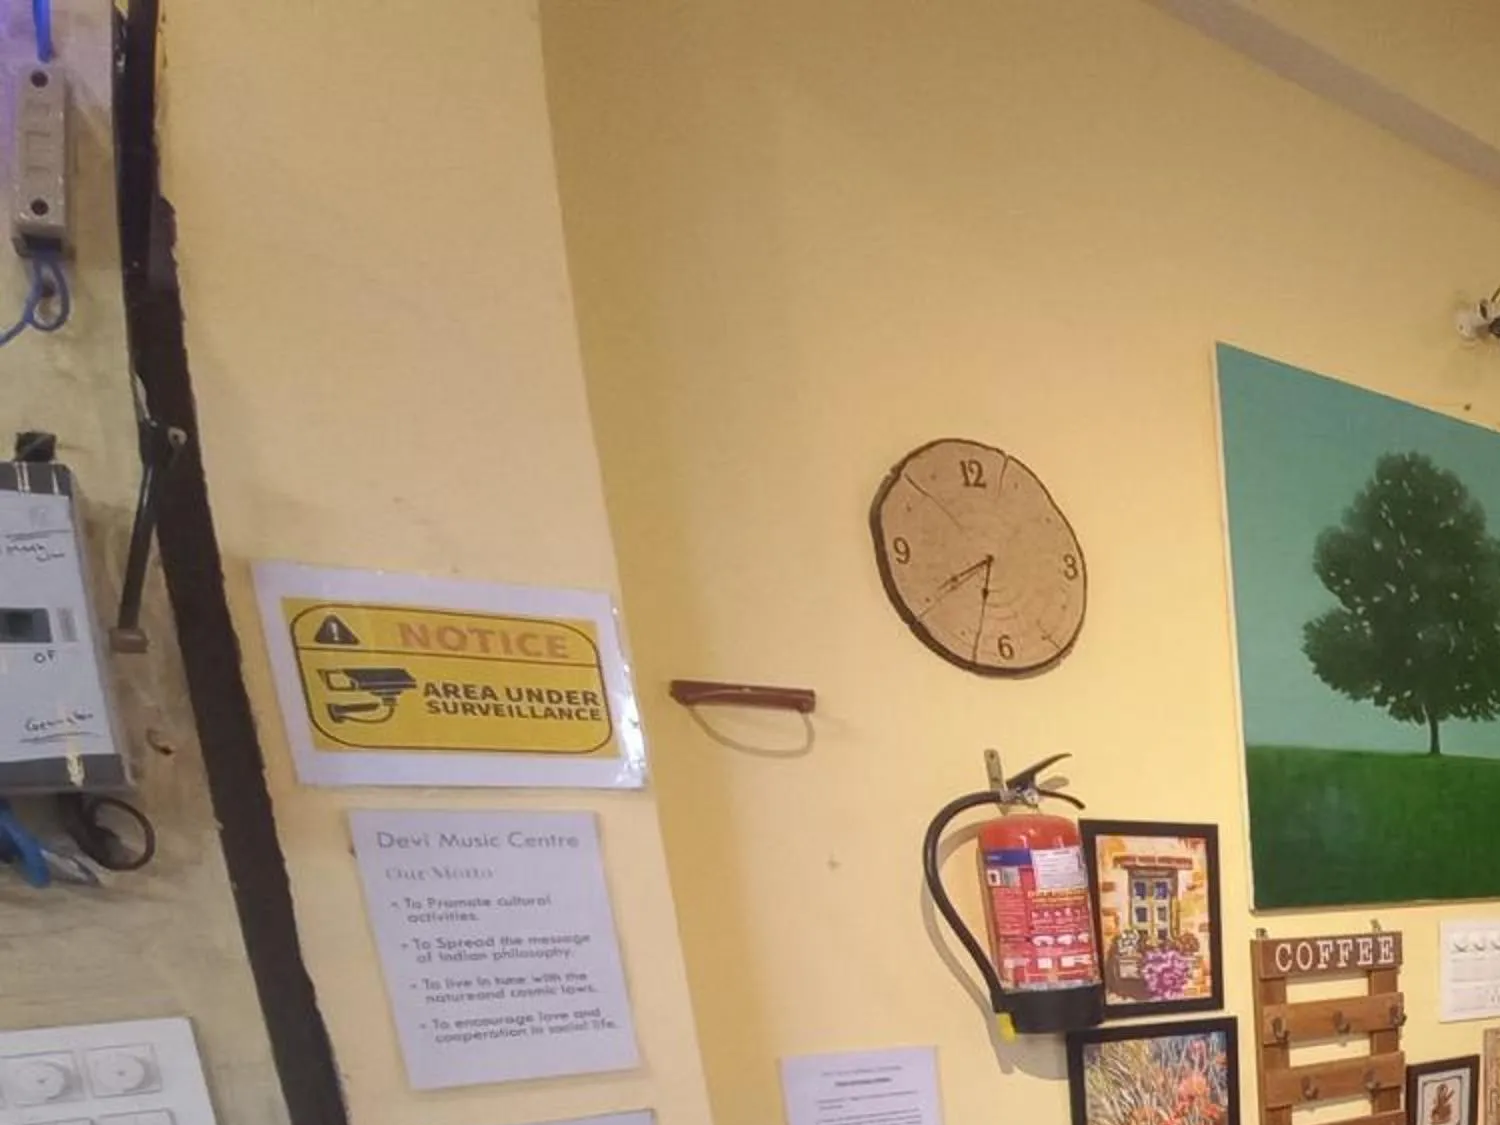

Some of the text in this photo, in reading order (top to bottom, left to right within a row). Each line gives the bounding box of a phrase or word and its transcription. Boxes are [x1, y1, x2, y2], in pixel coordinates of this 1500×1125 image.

[959, 459, 987, 489] 12
[893, 537, 911, 564] 9
[1063, 553, 1078, 581] 3
[398, 624, 570, 658] NOTICE
[997, 634, 1015, 660] 6
[424, 682, 600, 706] AREA UNDER
[427, 701, 601, 721] SURVEILLANCE
[376, 831, 580, 849] Devi Music Centre
[404, 895, 552, 910] To Promote cultural
[412, 933, 592, 951] To Spread the message
[1274, 934, 1396, 973] COFFEE
[415, 952, 433, 964] of
[438, 949, 489, 962] Indian
[421, 978, 441, 990] To
[445, 976, 474, 988] live
[476, 976, 493, 987] in
[531, 973, 562, 983] with
[431, 1007, 602, 1030] To encourage love and
